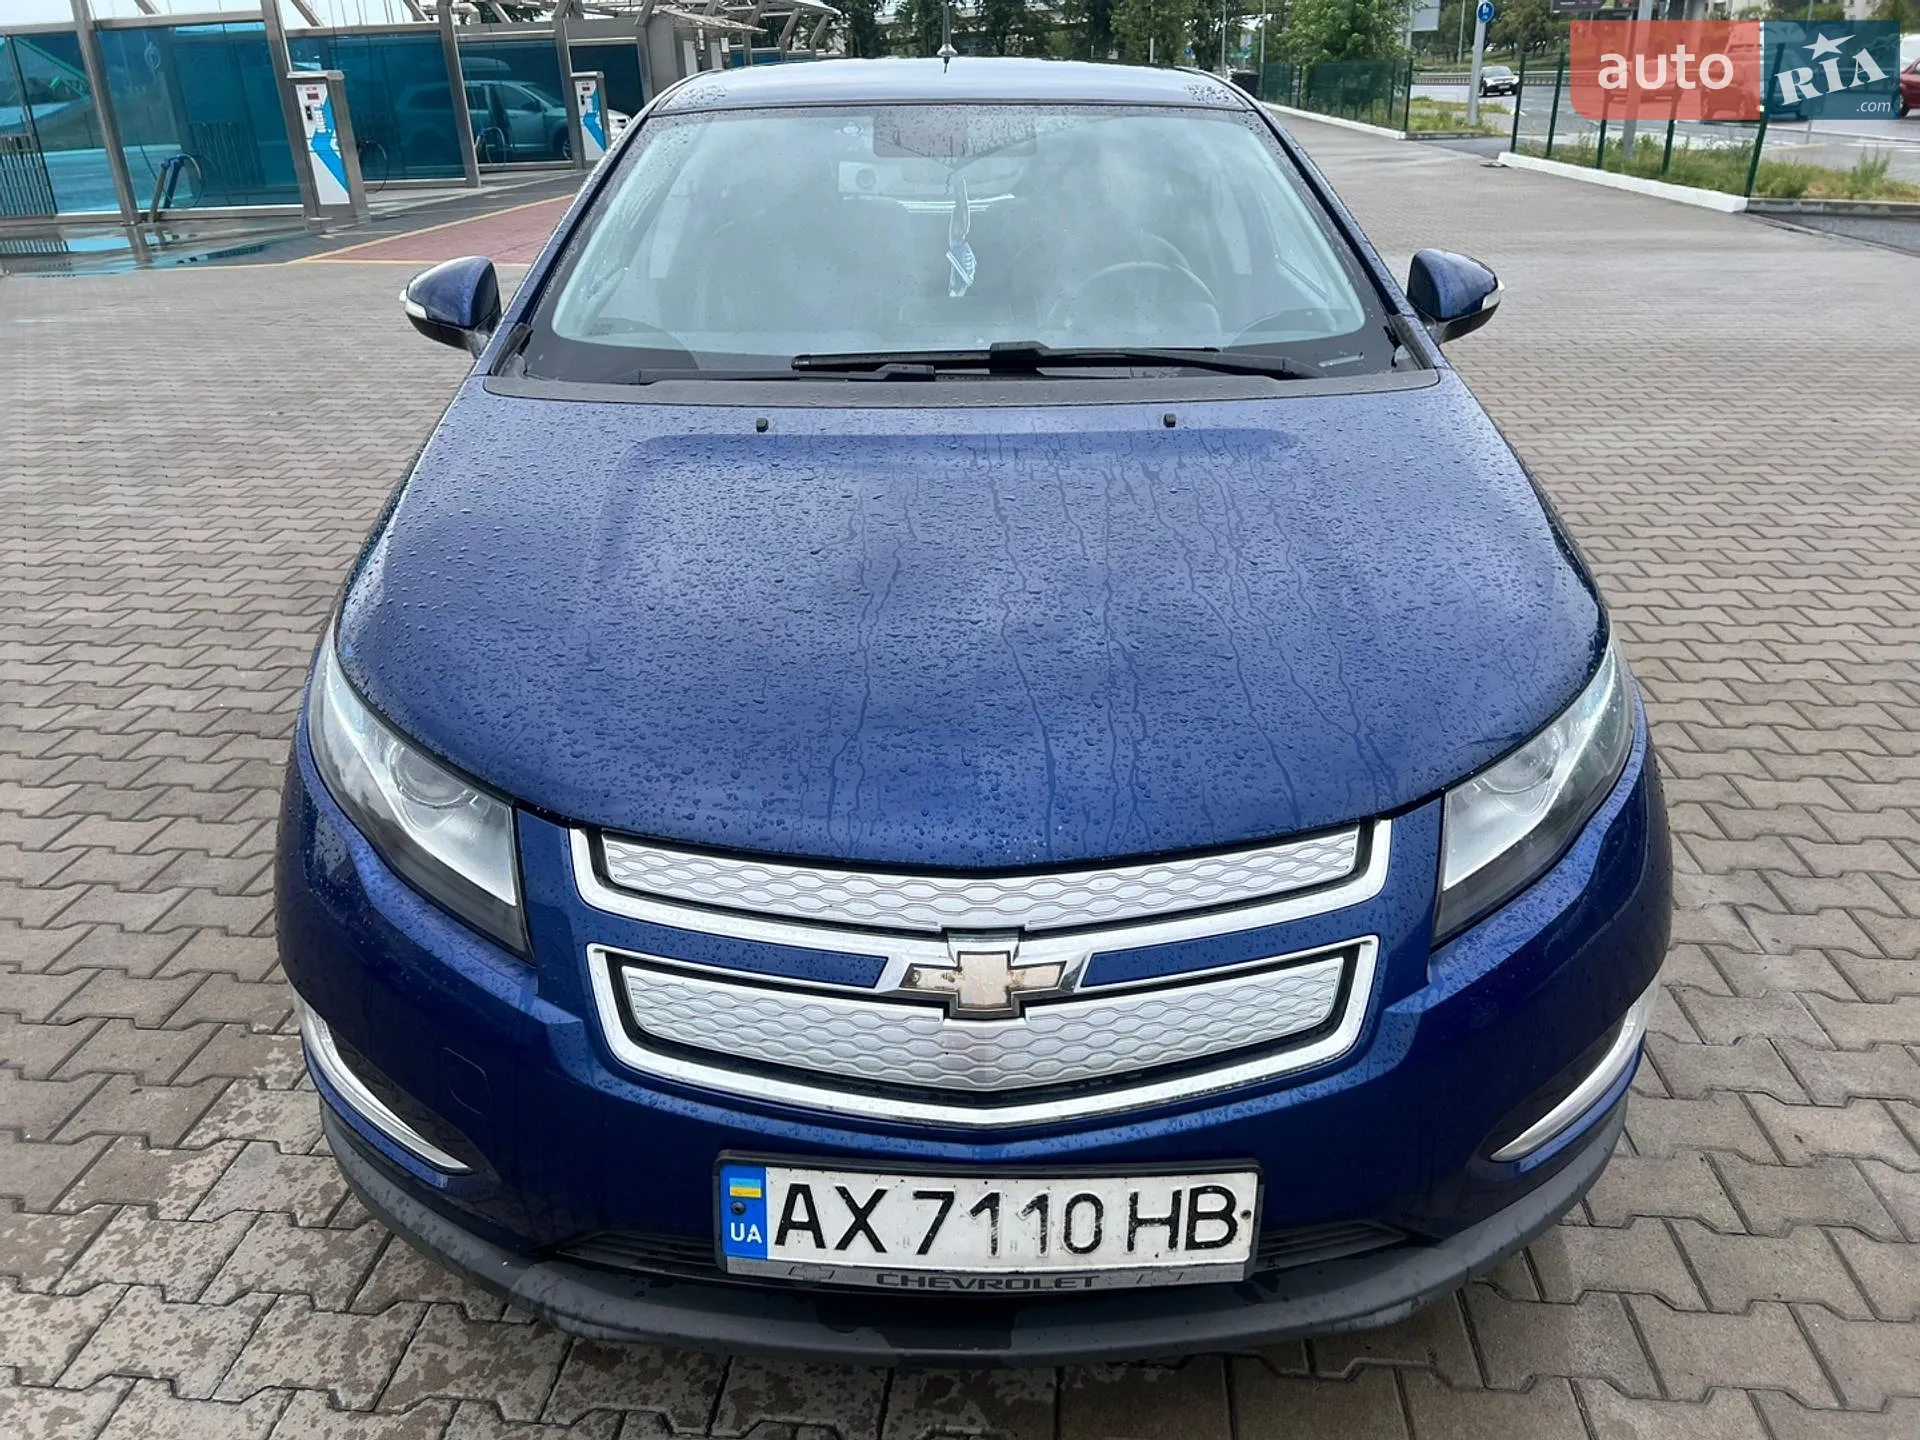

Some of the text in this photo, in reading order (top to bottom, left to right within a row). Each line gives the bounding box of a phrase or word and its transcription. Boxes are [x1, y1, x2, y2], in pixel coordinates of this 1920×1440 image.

[774, 1182, 1239, 1257] AX 7110 HB
[730, 1222, 762, 1244] UA
[876, 1272, 1100, 1290] CHEVROLET
